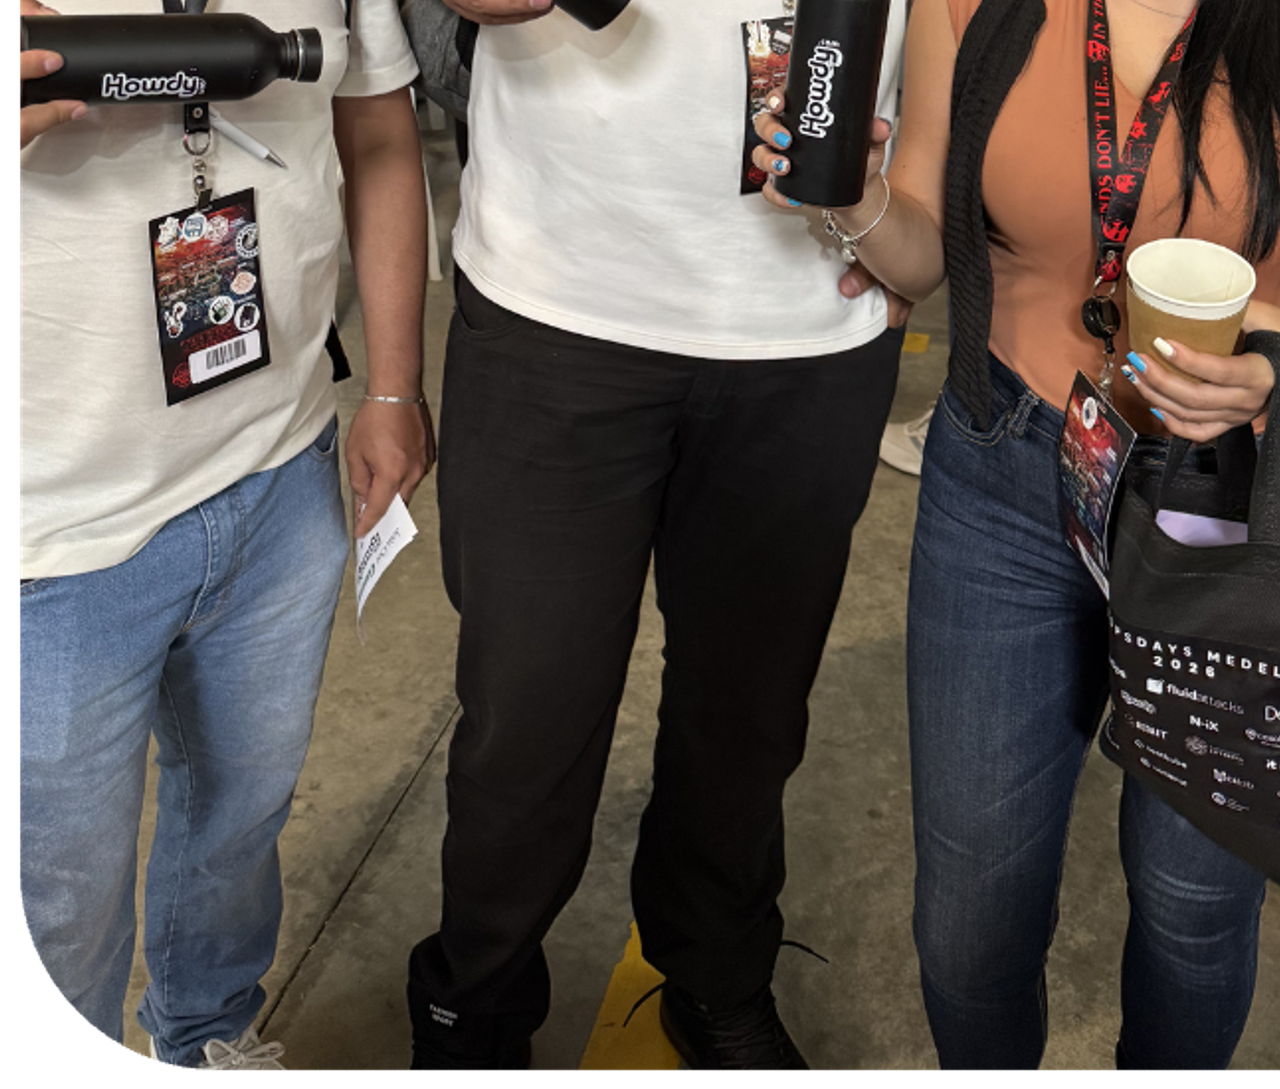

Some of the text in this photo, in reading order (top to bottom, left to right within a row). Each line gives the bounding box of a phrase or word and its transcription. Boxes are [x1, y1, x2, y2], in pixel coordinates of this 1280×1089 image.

[101, 70, 200, 100] Howdy
[799, 45, 842, 139] Howdy
[1096, 111, 1113, 169] DON'T
[1098, 174, 1114, 225] NDS
[1153, 656, 1215, 678] 2026
